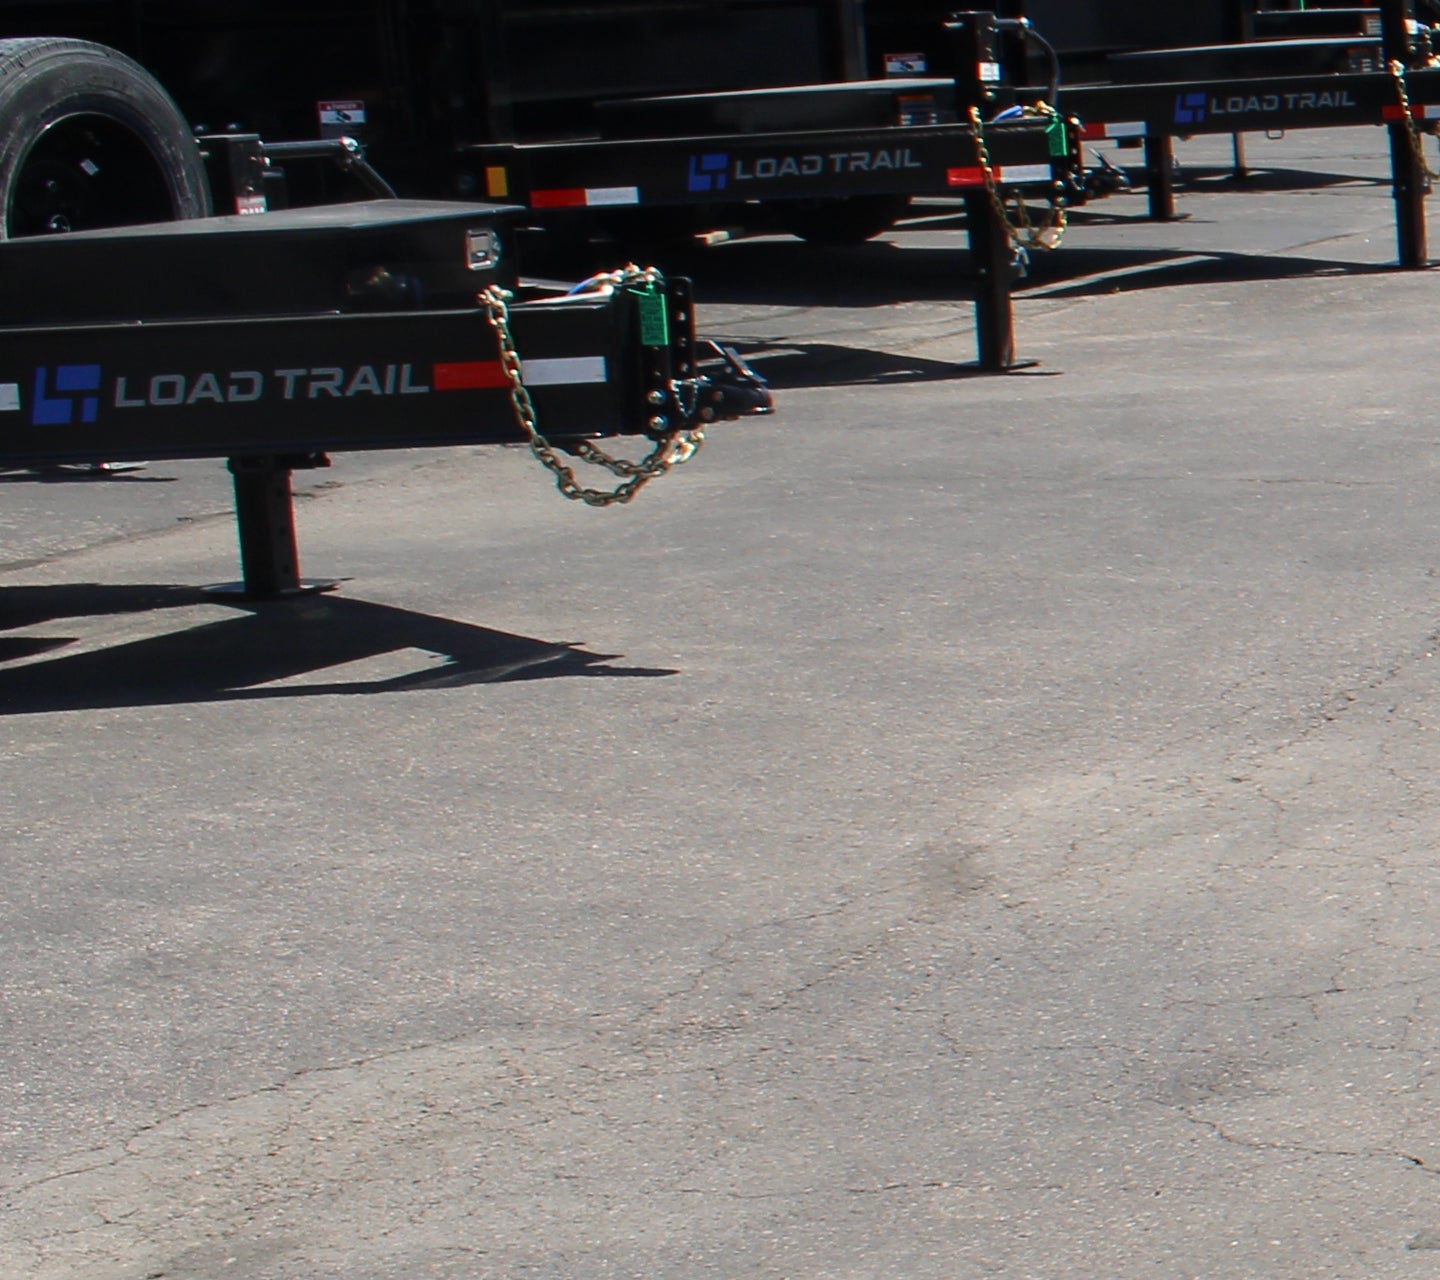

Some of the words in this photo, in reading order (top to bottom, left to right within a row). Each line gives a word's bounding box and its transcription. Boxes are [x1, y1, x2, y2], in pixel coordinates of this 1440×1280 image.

[1210, 94, 1280, 114] LOAD
[1283, 90, 1356, 109] TRAIL
[735, 155, 823, 180] LOAD
[828, 148, 922, 173] TRAIL
[114, 370, 264, 408] LOAD
[274, 363, 430, 400] TRAIL
